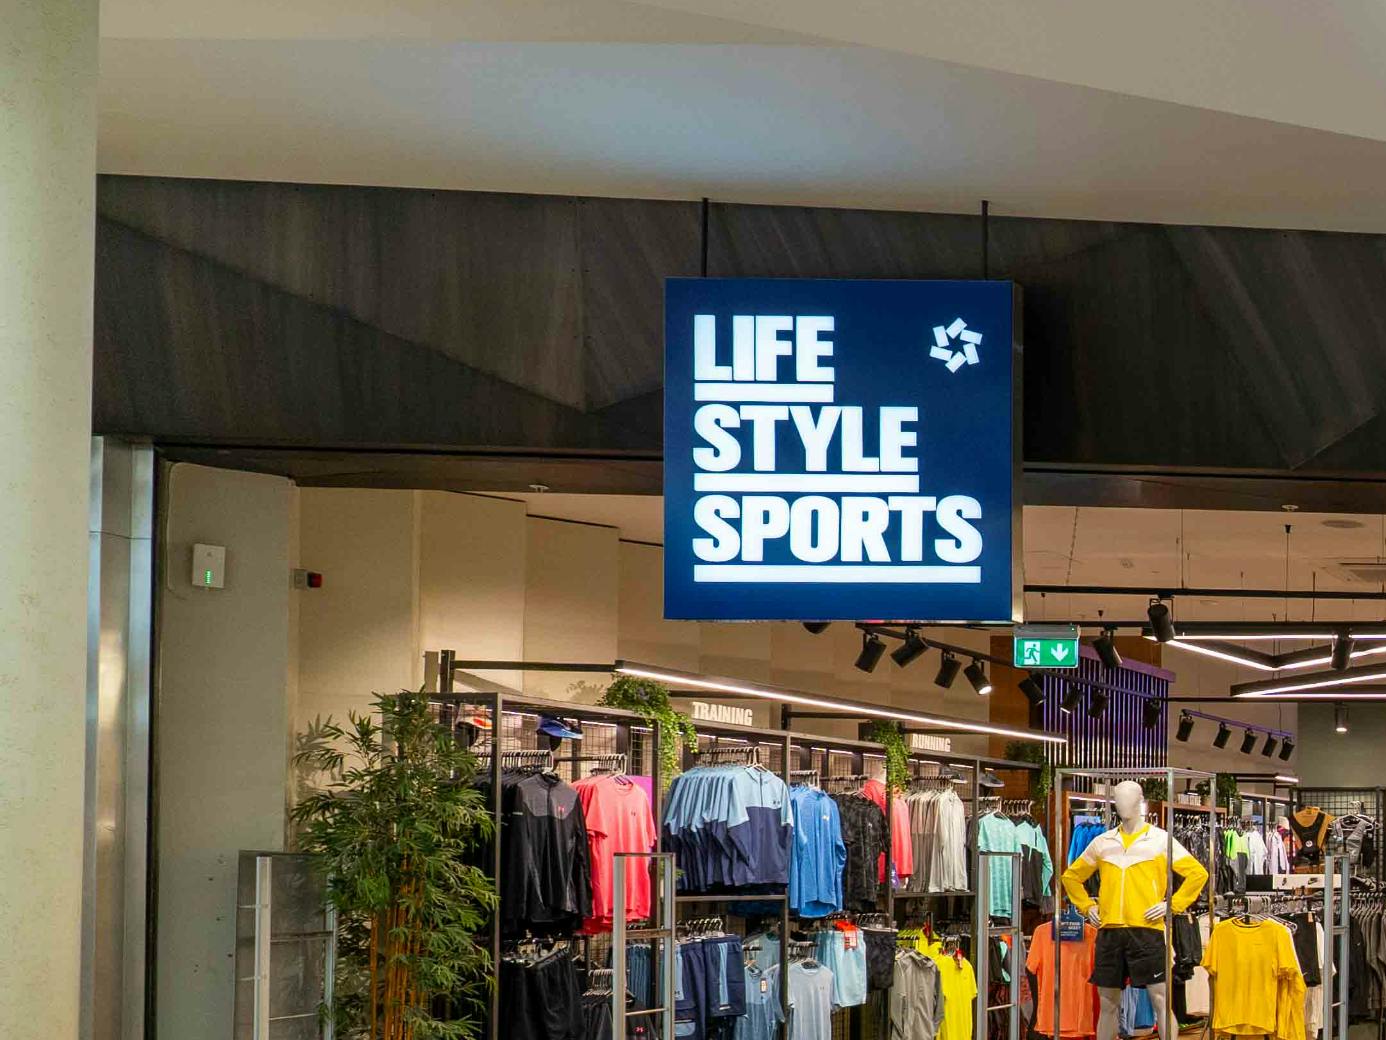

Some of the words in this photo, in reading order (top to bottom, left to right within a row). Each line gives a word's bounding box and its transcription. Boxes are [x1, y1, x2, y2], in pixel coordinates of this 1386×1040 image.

[694, 314, 835, 382] LIFE
[693, 404, 919, 472] STYLE
[692, 495, 983, 563] SPORTS
[692, 701, 753, 726] TRAINING
[912, 733, 951, 751] RUNNING
